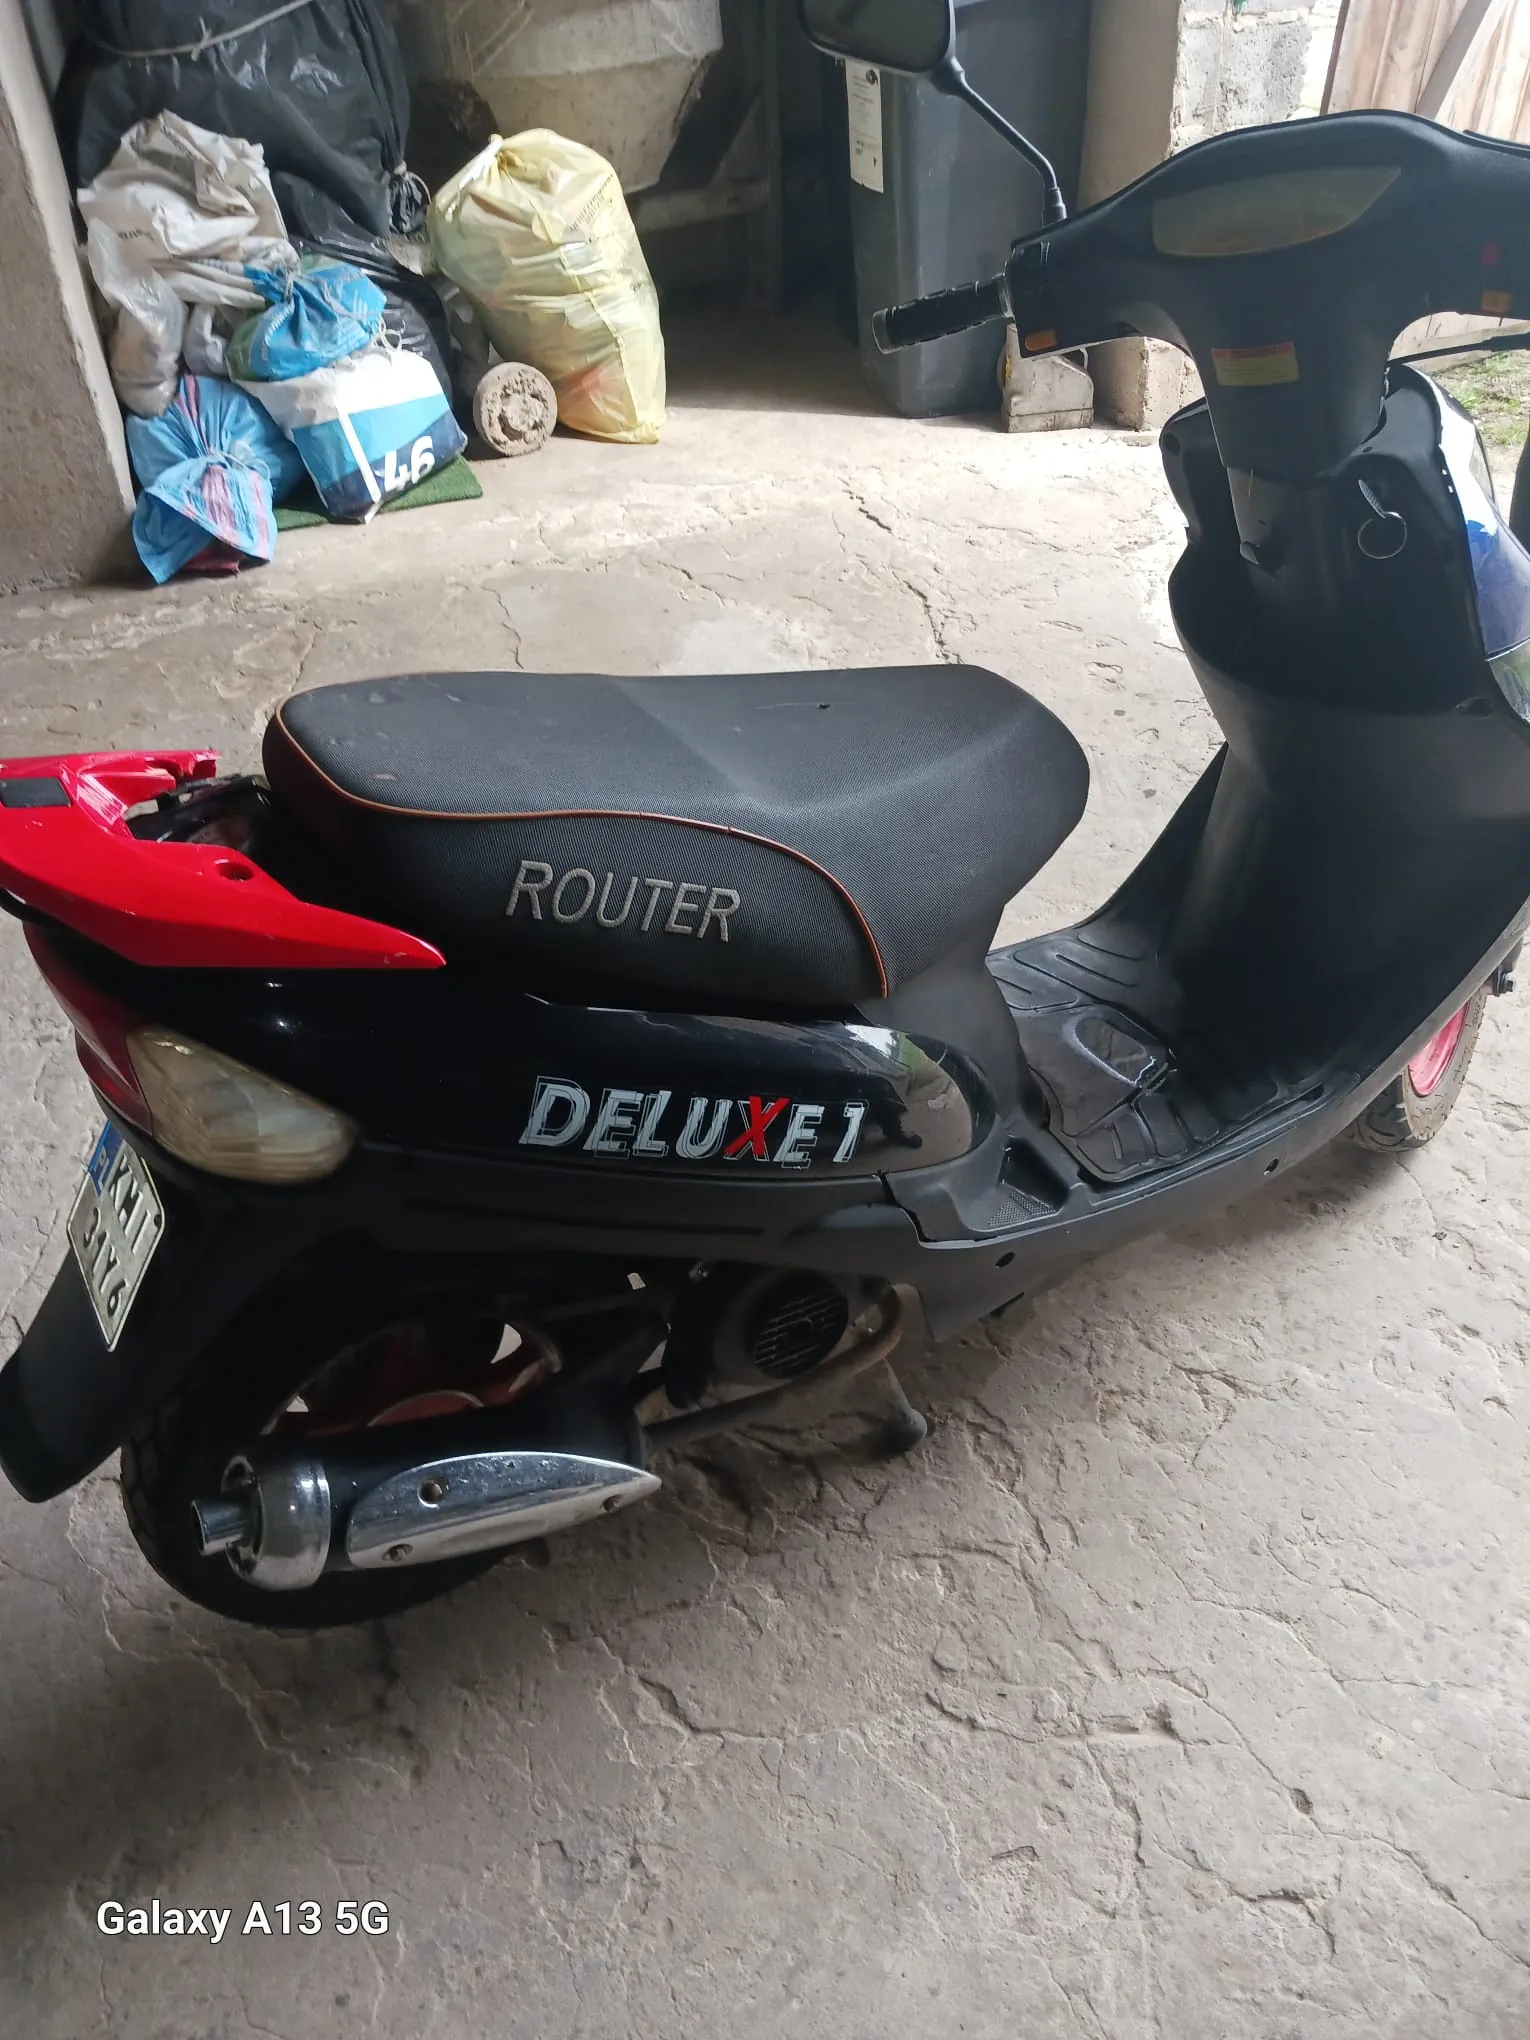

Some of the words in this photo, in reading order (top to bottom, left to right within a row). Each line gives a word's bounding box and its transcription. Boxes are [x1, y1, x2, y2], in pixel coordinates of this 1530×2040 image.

[505, 860, 742, 942] ROUTER
[518, 1075, 825, 1168] DELUXE
[832, 1099, 870, 1164] 1
